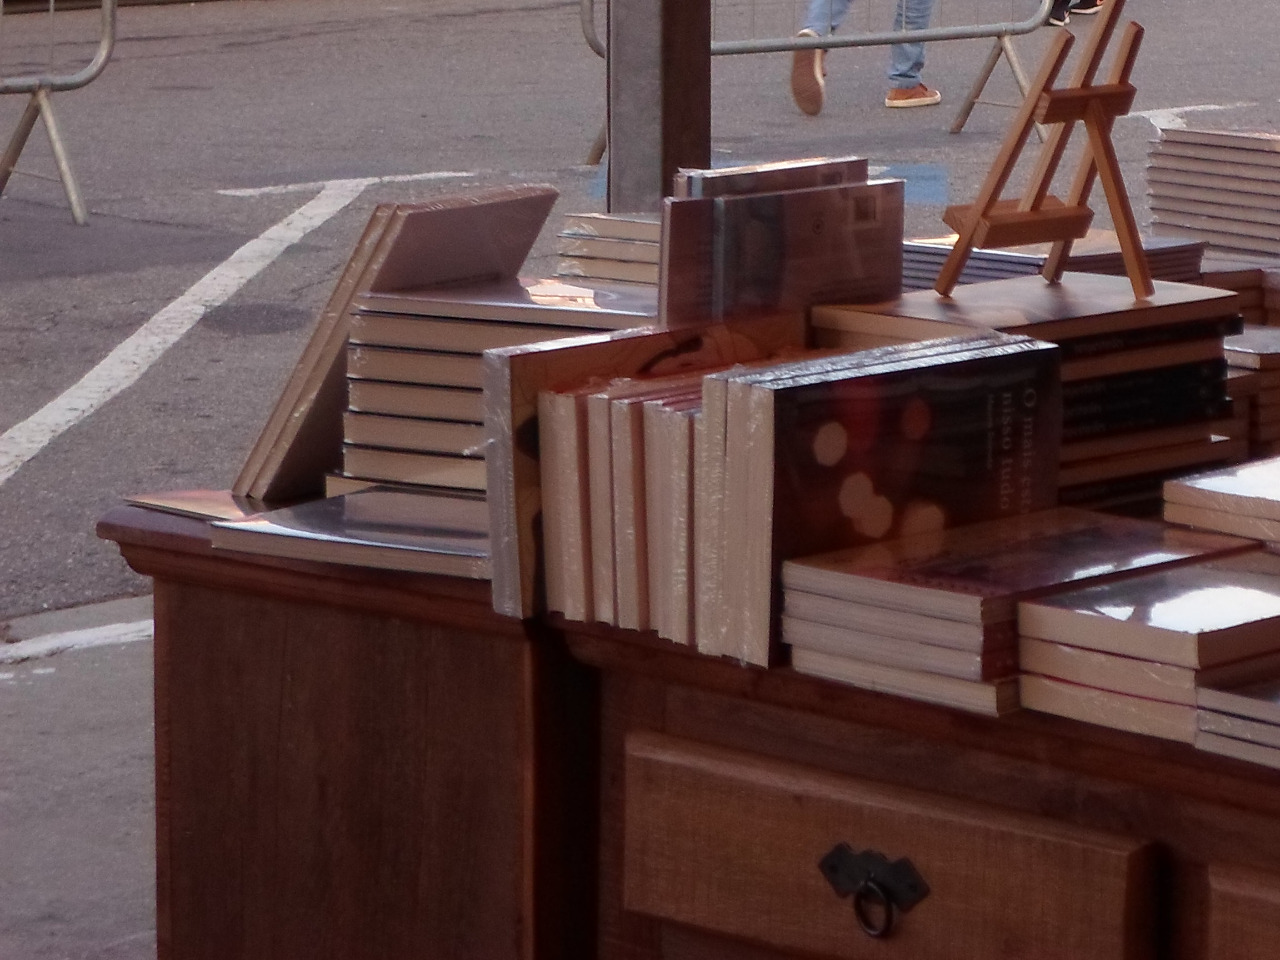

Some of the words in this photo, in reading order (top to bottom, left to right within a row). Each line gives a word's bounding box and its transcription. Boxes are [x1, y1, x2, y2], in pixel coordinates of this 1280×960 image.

[1001, 393, 1016, 450] nisso
[1024, 388, 1037, 408] O
[1022, 417, 1037, 469] mais
[1000, 458, 1015, 510] tudo
